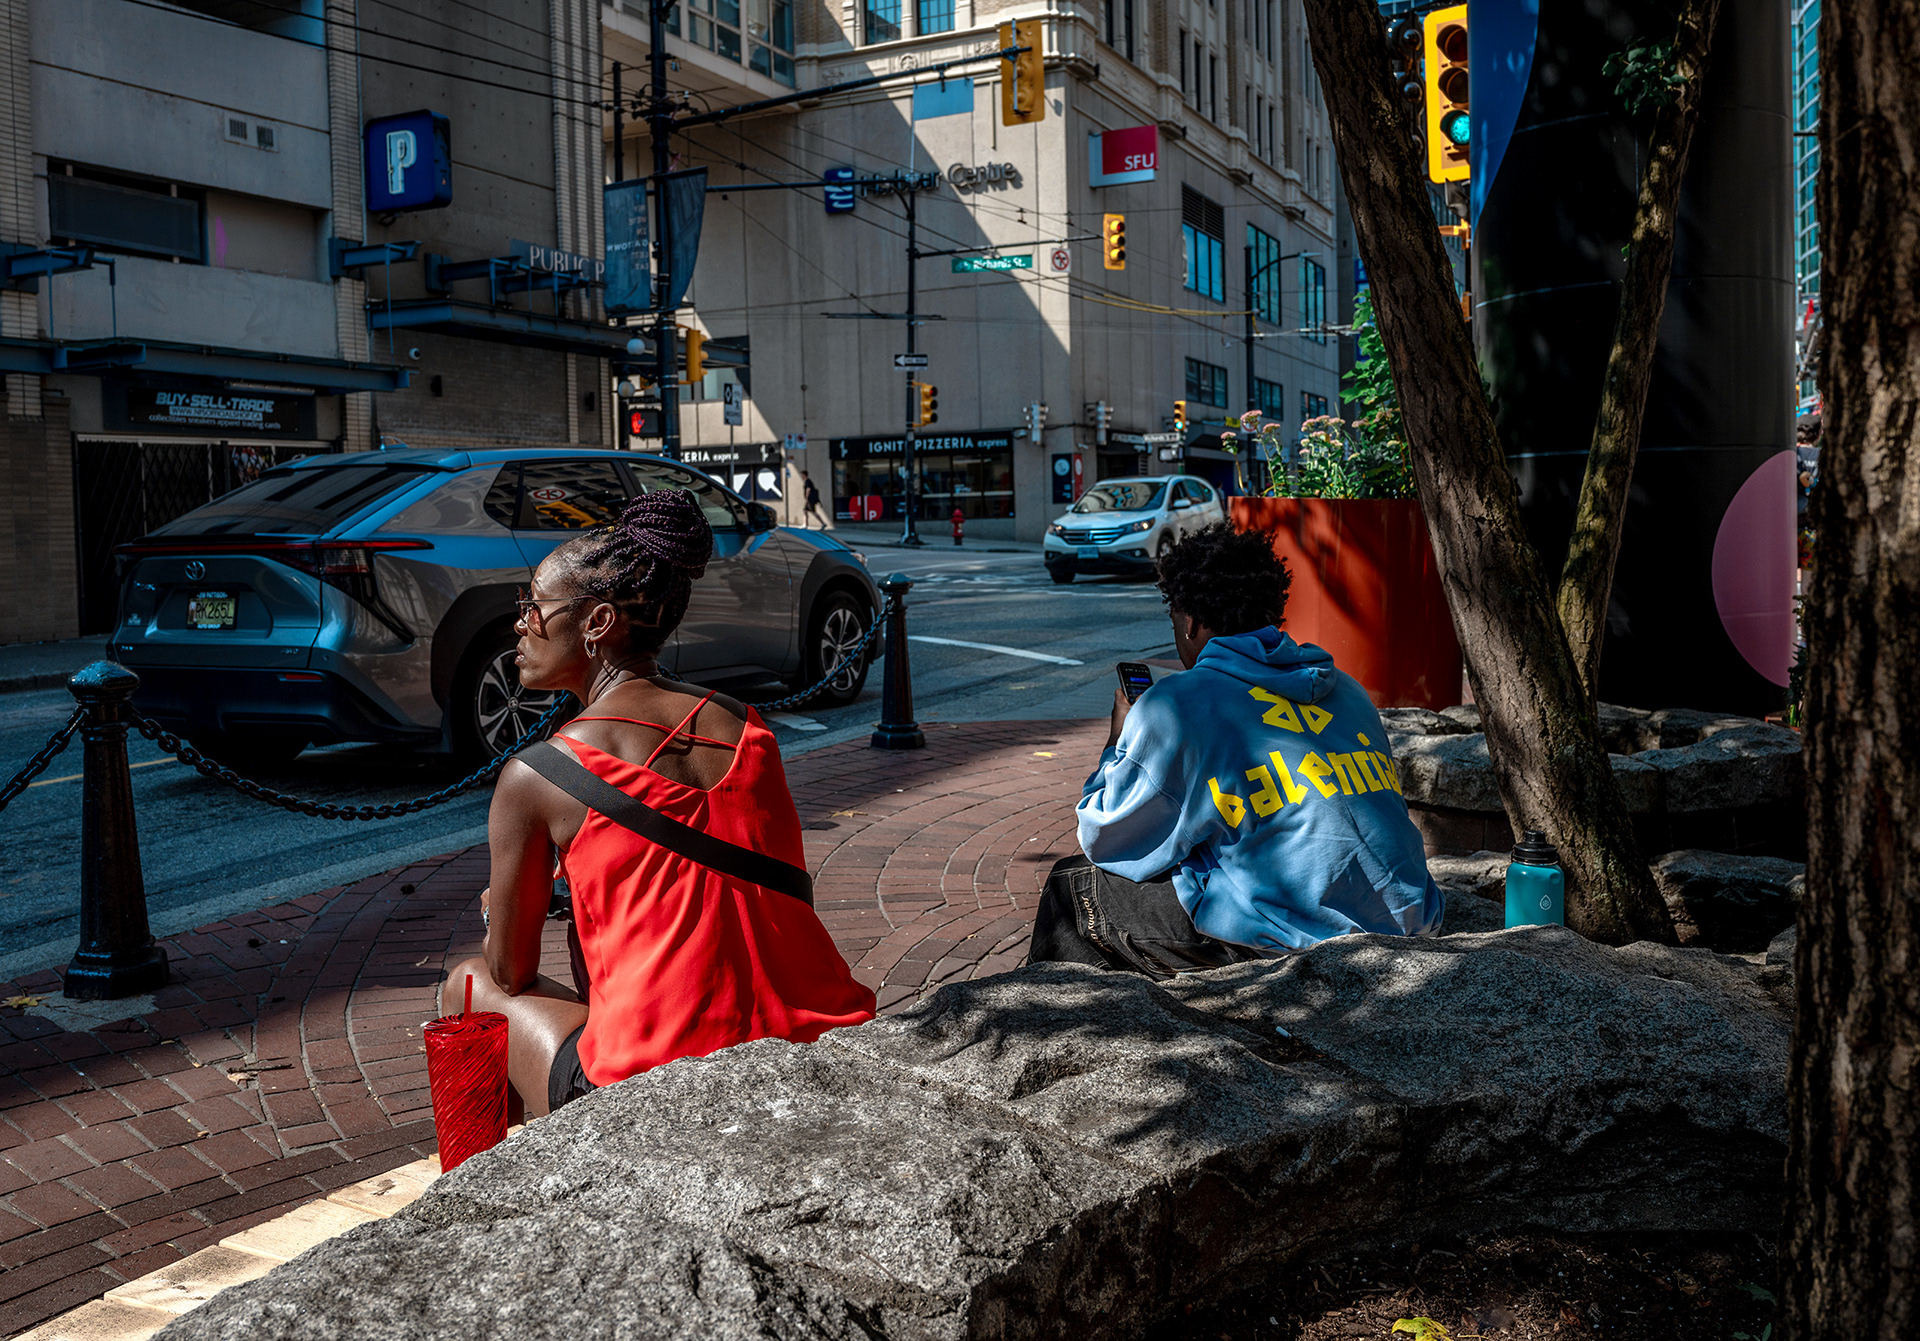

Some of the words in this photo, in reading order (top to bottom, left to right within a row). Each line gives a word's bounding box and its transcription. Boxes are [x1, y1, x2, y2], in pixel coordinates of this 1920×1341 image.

[385, 129, 418, 195] P
[1124, 152, 1154, 170] SFU
[948, 161, 1017, 187] Centre
[530, 245, 591, 279] PUBLIC
[973, 258, 1012, 270] Richards
[868, 440, 906, 454] IGNIT
[914, 436, 974, 451] PIZZERIA
[976, 438, 1008, 450] express
